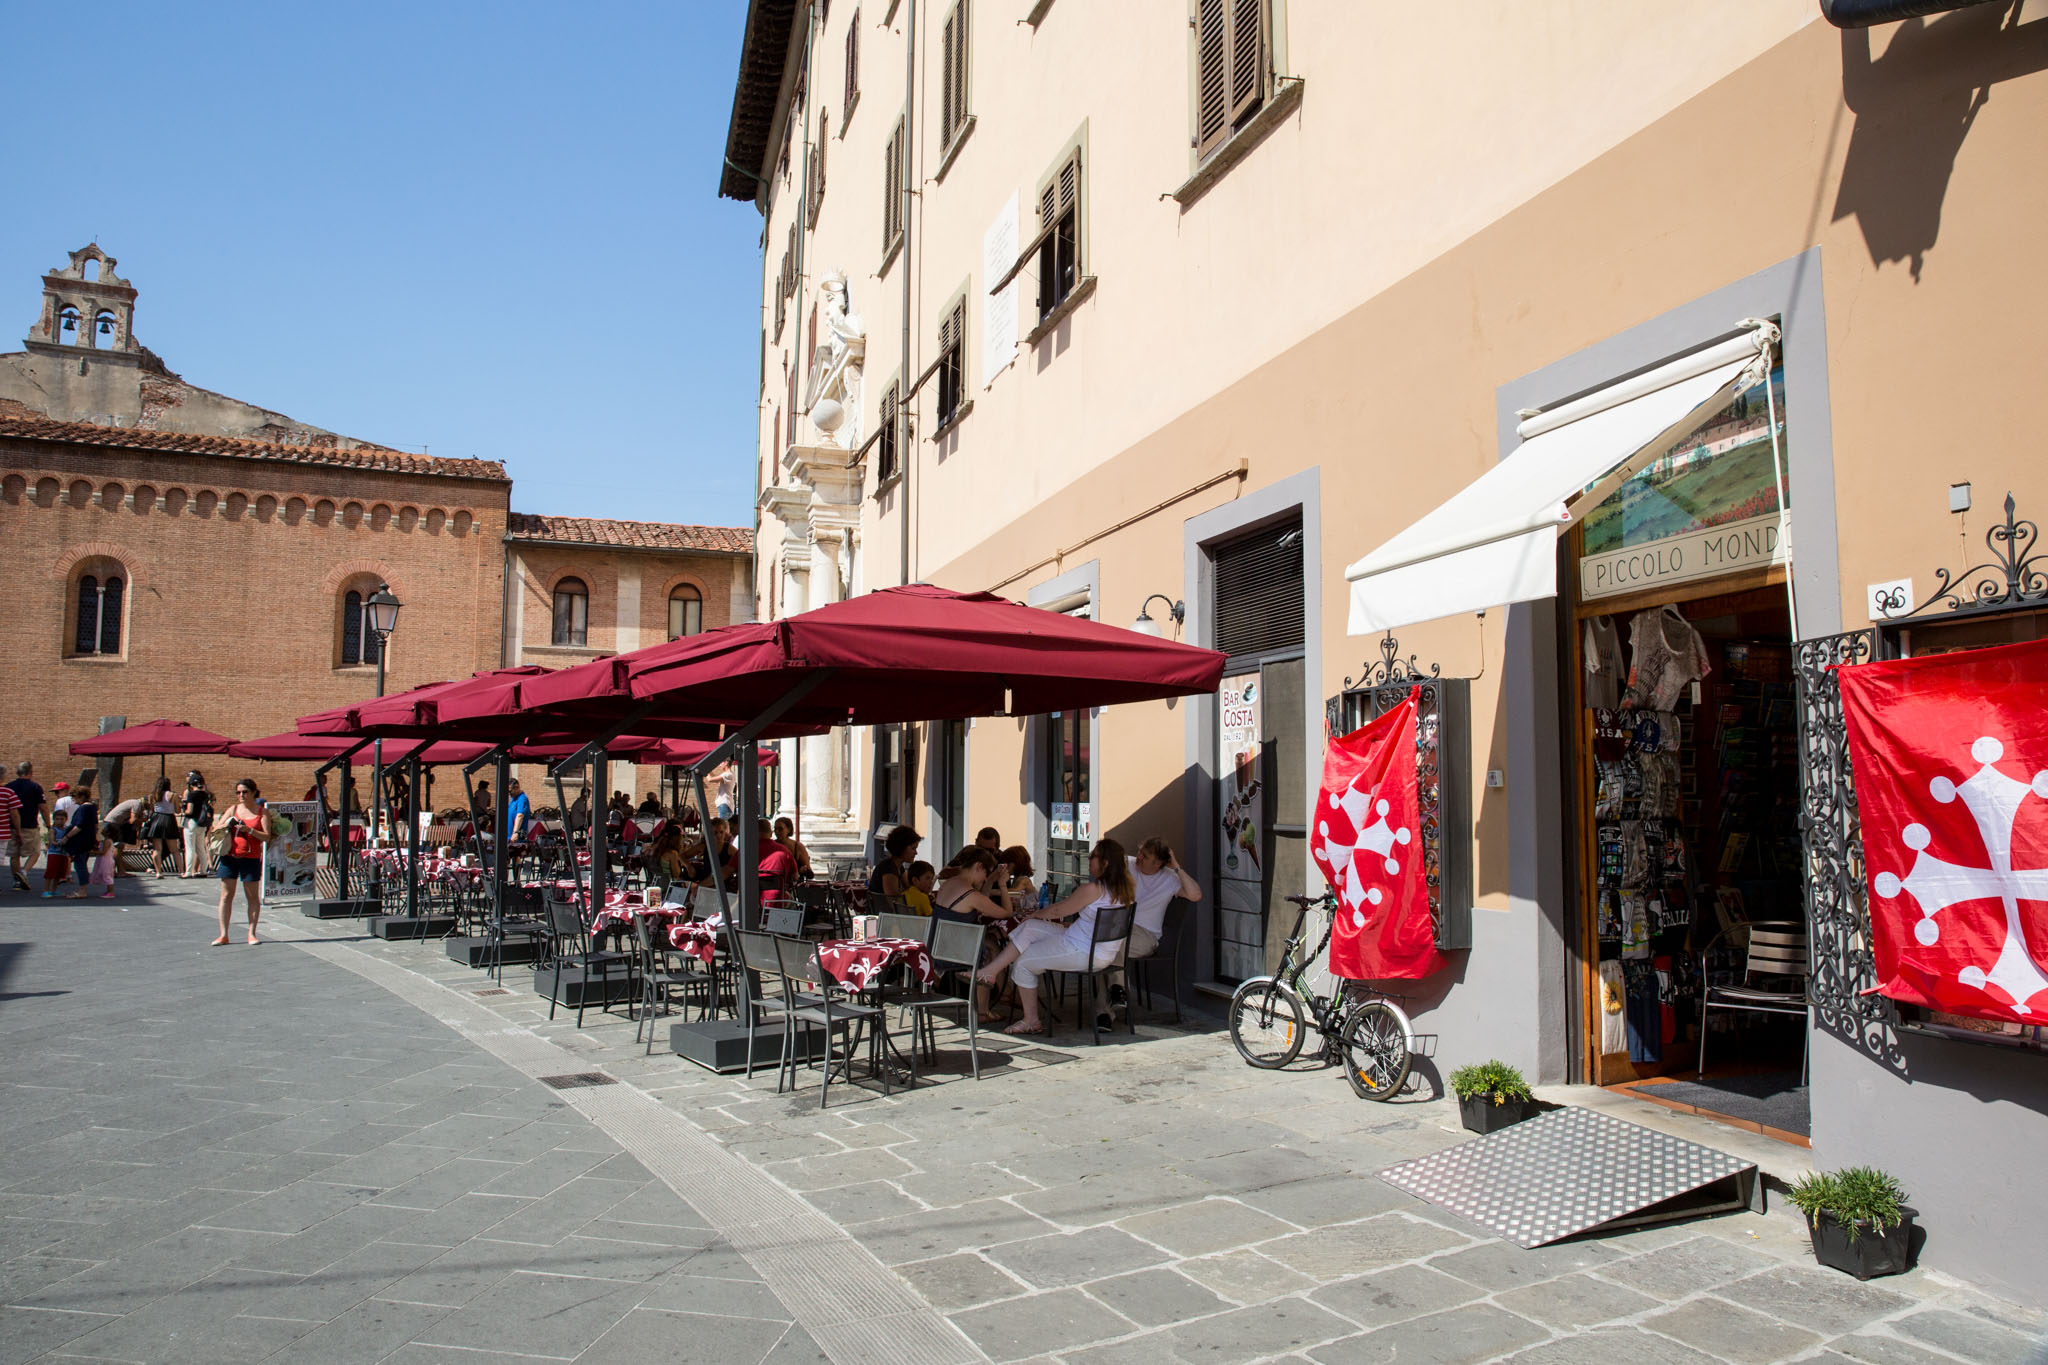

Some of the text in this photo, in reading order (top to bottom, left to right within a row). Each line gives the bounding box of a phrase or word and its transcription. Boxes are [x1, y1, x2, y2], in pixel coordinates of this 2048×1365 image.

[1597, 547, 1684, 588] PICCOLO
[1875, 586, 1906, 611] 96
[1223, 691, 1240, 707] BAR
[1223, 708, 1254, 728] COSTA
[279, 804, 317, 813] GELATERIA
[265, 887, 302, 897] BAR COSTA
